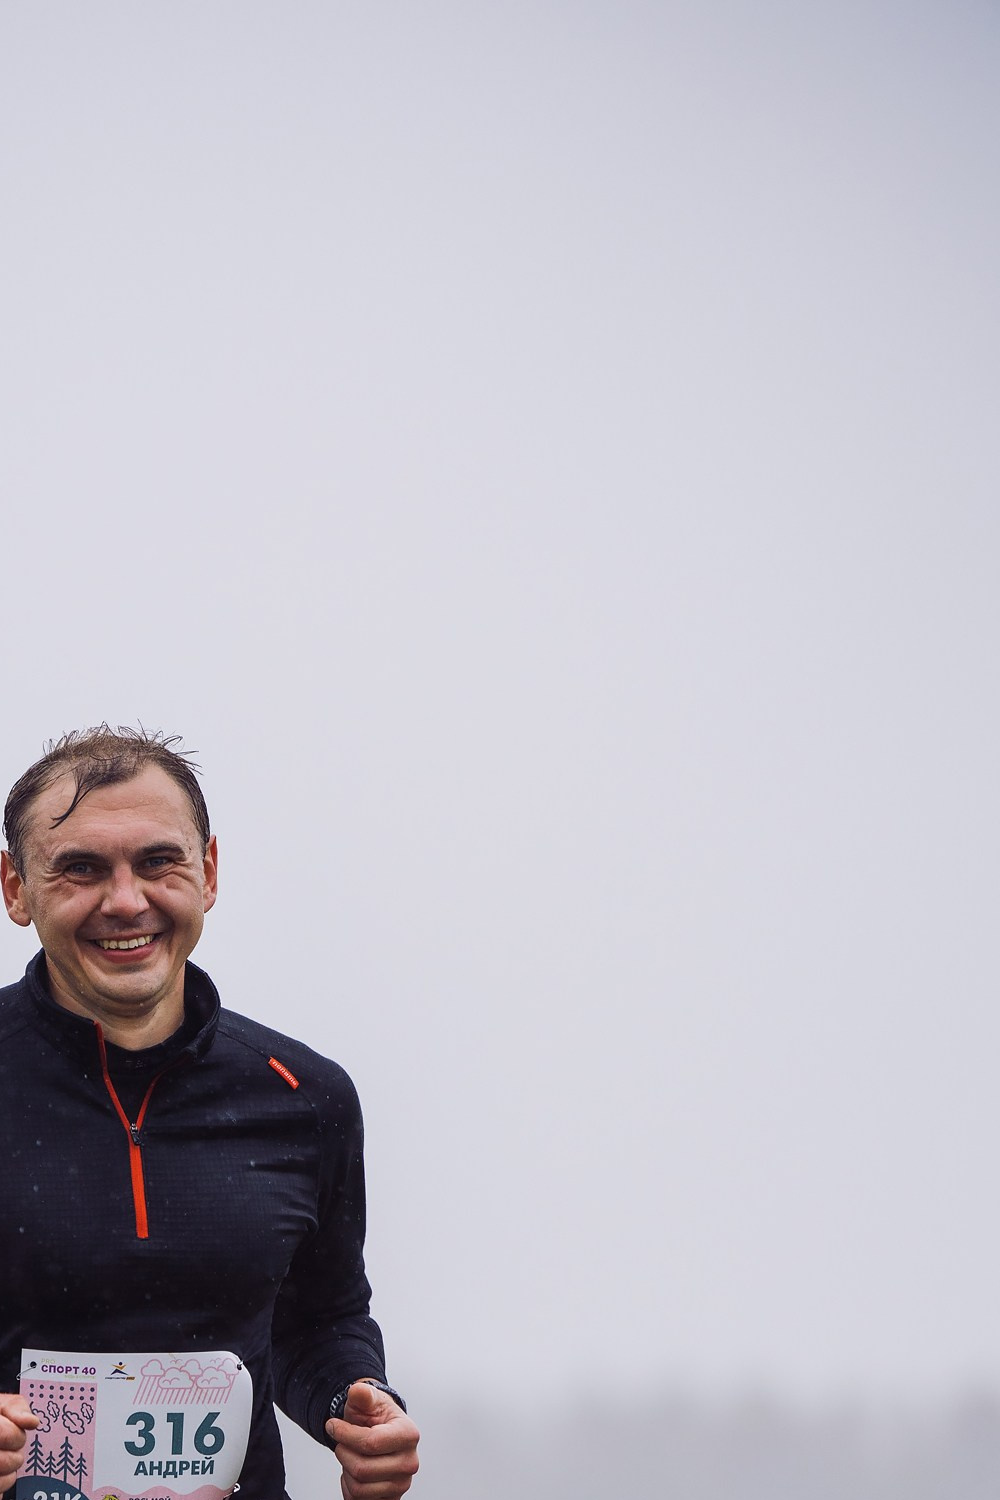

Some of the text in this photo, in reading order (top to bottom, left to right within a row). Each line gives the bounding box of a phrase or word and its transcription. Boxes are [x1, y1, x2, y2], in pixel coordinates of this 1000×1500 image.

[41, 1364, 97, 1375] СПОРТ 40
[124, 1411, 225, 1457] 316
[134, 1456, 215, 1479] АНДРЕЙ
